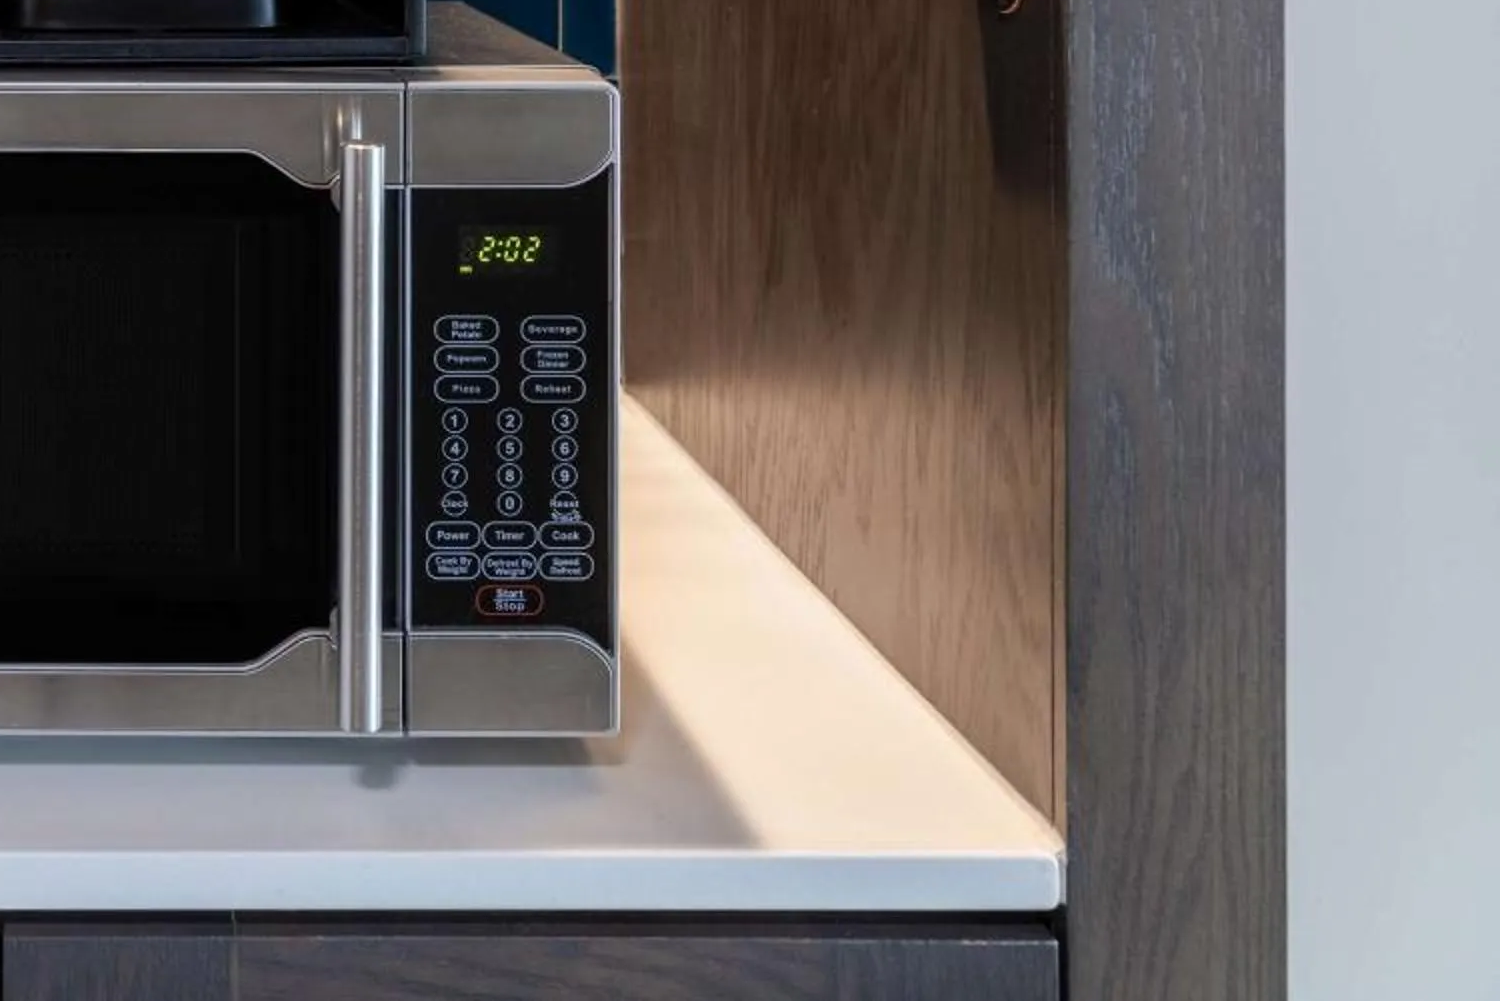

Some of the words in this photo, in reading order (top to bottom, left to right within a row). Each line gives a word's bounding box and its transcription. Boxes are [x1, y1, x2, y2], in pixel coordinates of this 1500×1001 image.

[478, 236, 541, 262] 2:02
[528, 324, 578, 335] Beverage
[452, 384, 481, 394] Pizza
[535, 384, 572, 394] Reheat
[450, 414, 458, 428] 1
[505, 414, 515, 428] 2
[560, 414, 570, 428] 3
[450, 442, 460, 456] 4
[505, 442, 515, 456] 5
[560, 442, 570, 456] 6
[450, 469, 460, 483] 7
[505, 469, 515, 483] 8
[560, 469, 570, 483] 9
[505, 497, 515, 510] 0
[437, 530, 469, 540] Power
[495, 530, 524, 540] Timer
[552, 530, 579, 540] Cook
[496, 588, 523, 598] Start
[495, 602, 525, 614] Stop
